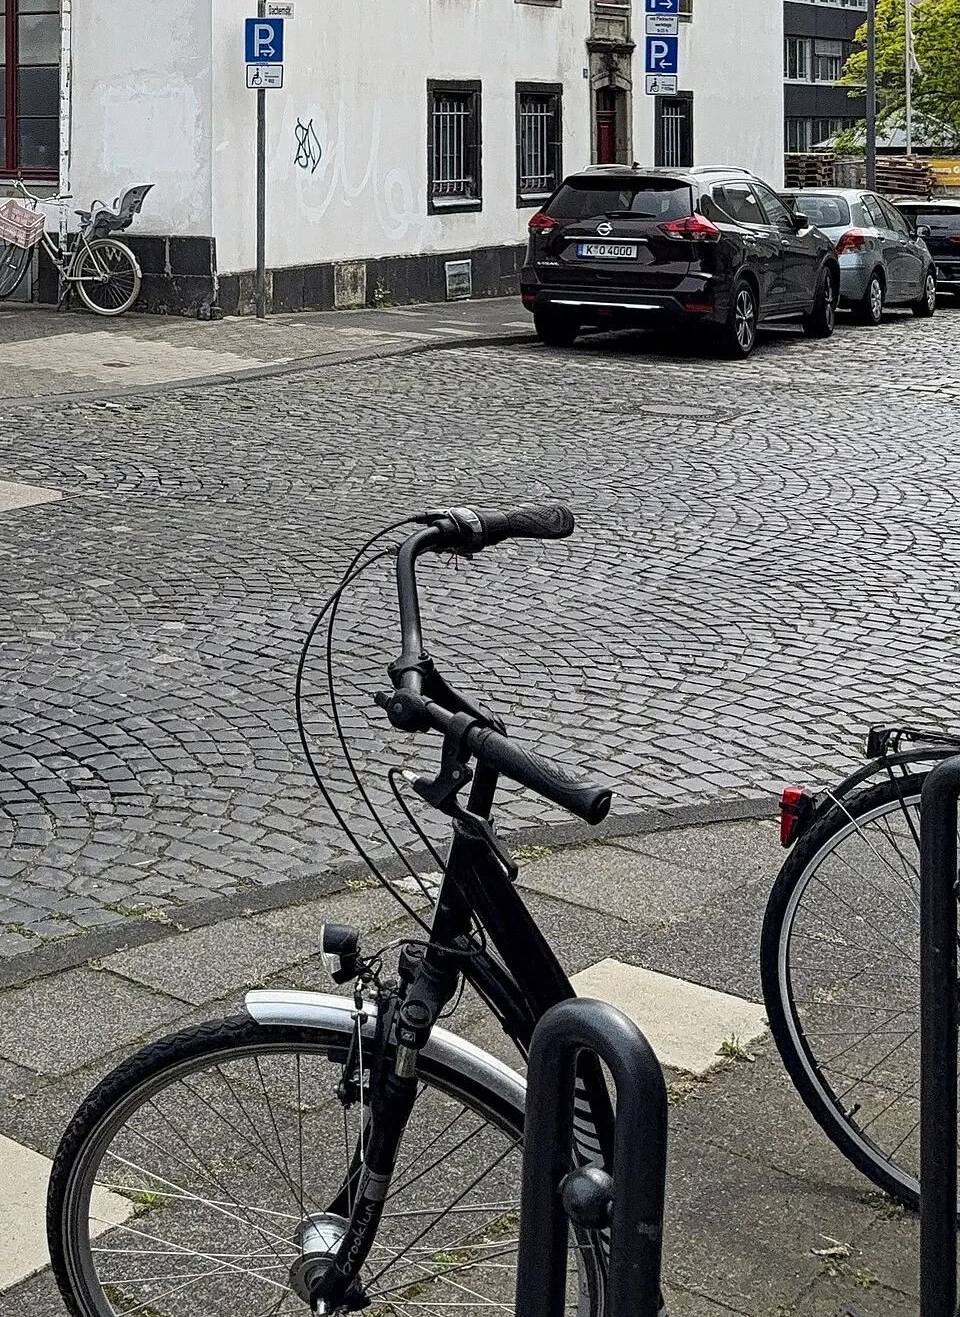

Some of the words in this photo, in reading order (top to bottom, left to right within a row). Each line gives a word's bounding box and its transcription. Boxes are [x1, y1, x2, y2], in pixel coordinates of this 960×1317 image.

[253, 24, 275, 57] P
[650, 40, 669, 69] P
[607, 245, 632, 256] 4000
